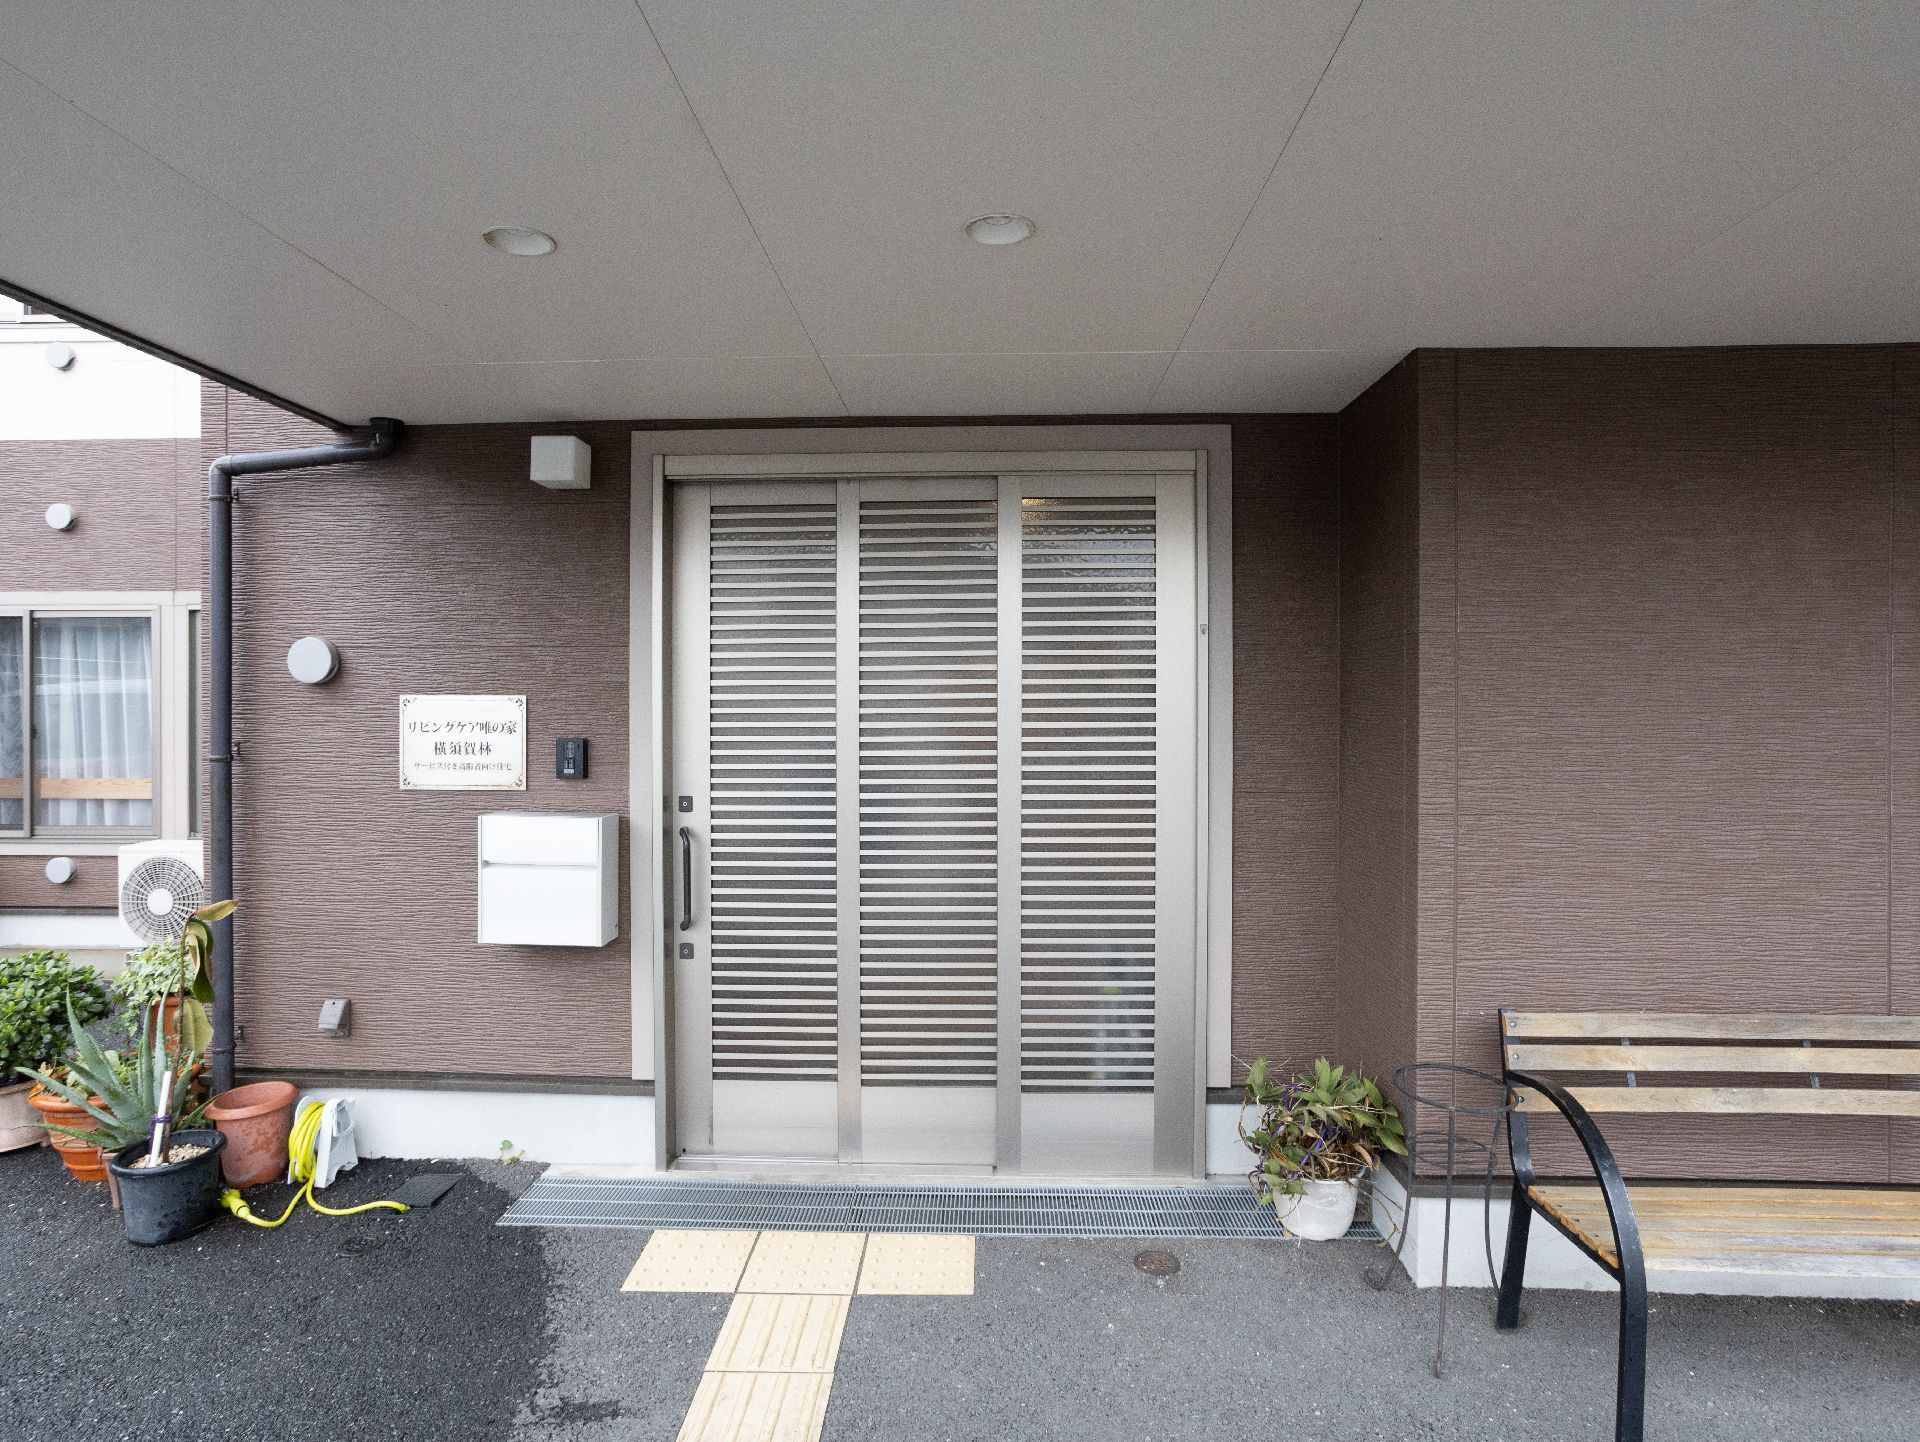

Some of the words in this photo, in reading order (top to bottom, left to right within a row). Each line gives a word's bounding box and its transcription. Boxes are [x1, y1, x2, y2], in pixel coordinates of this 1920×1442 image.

[408, 721, 517, 735] リビングケア唯の家
[434, 741, 492, 756] 横須賀林
